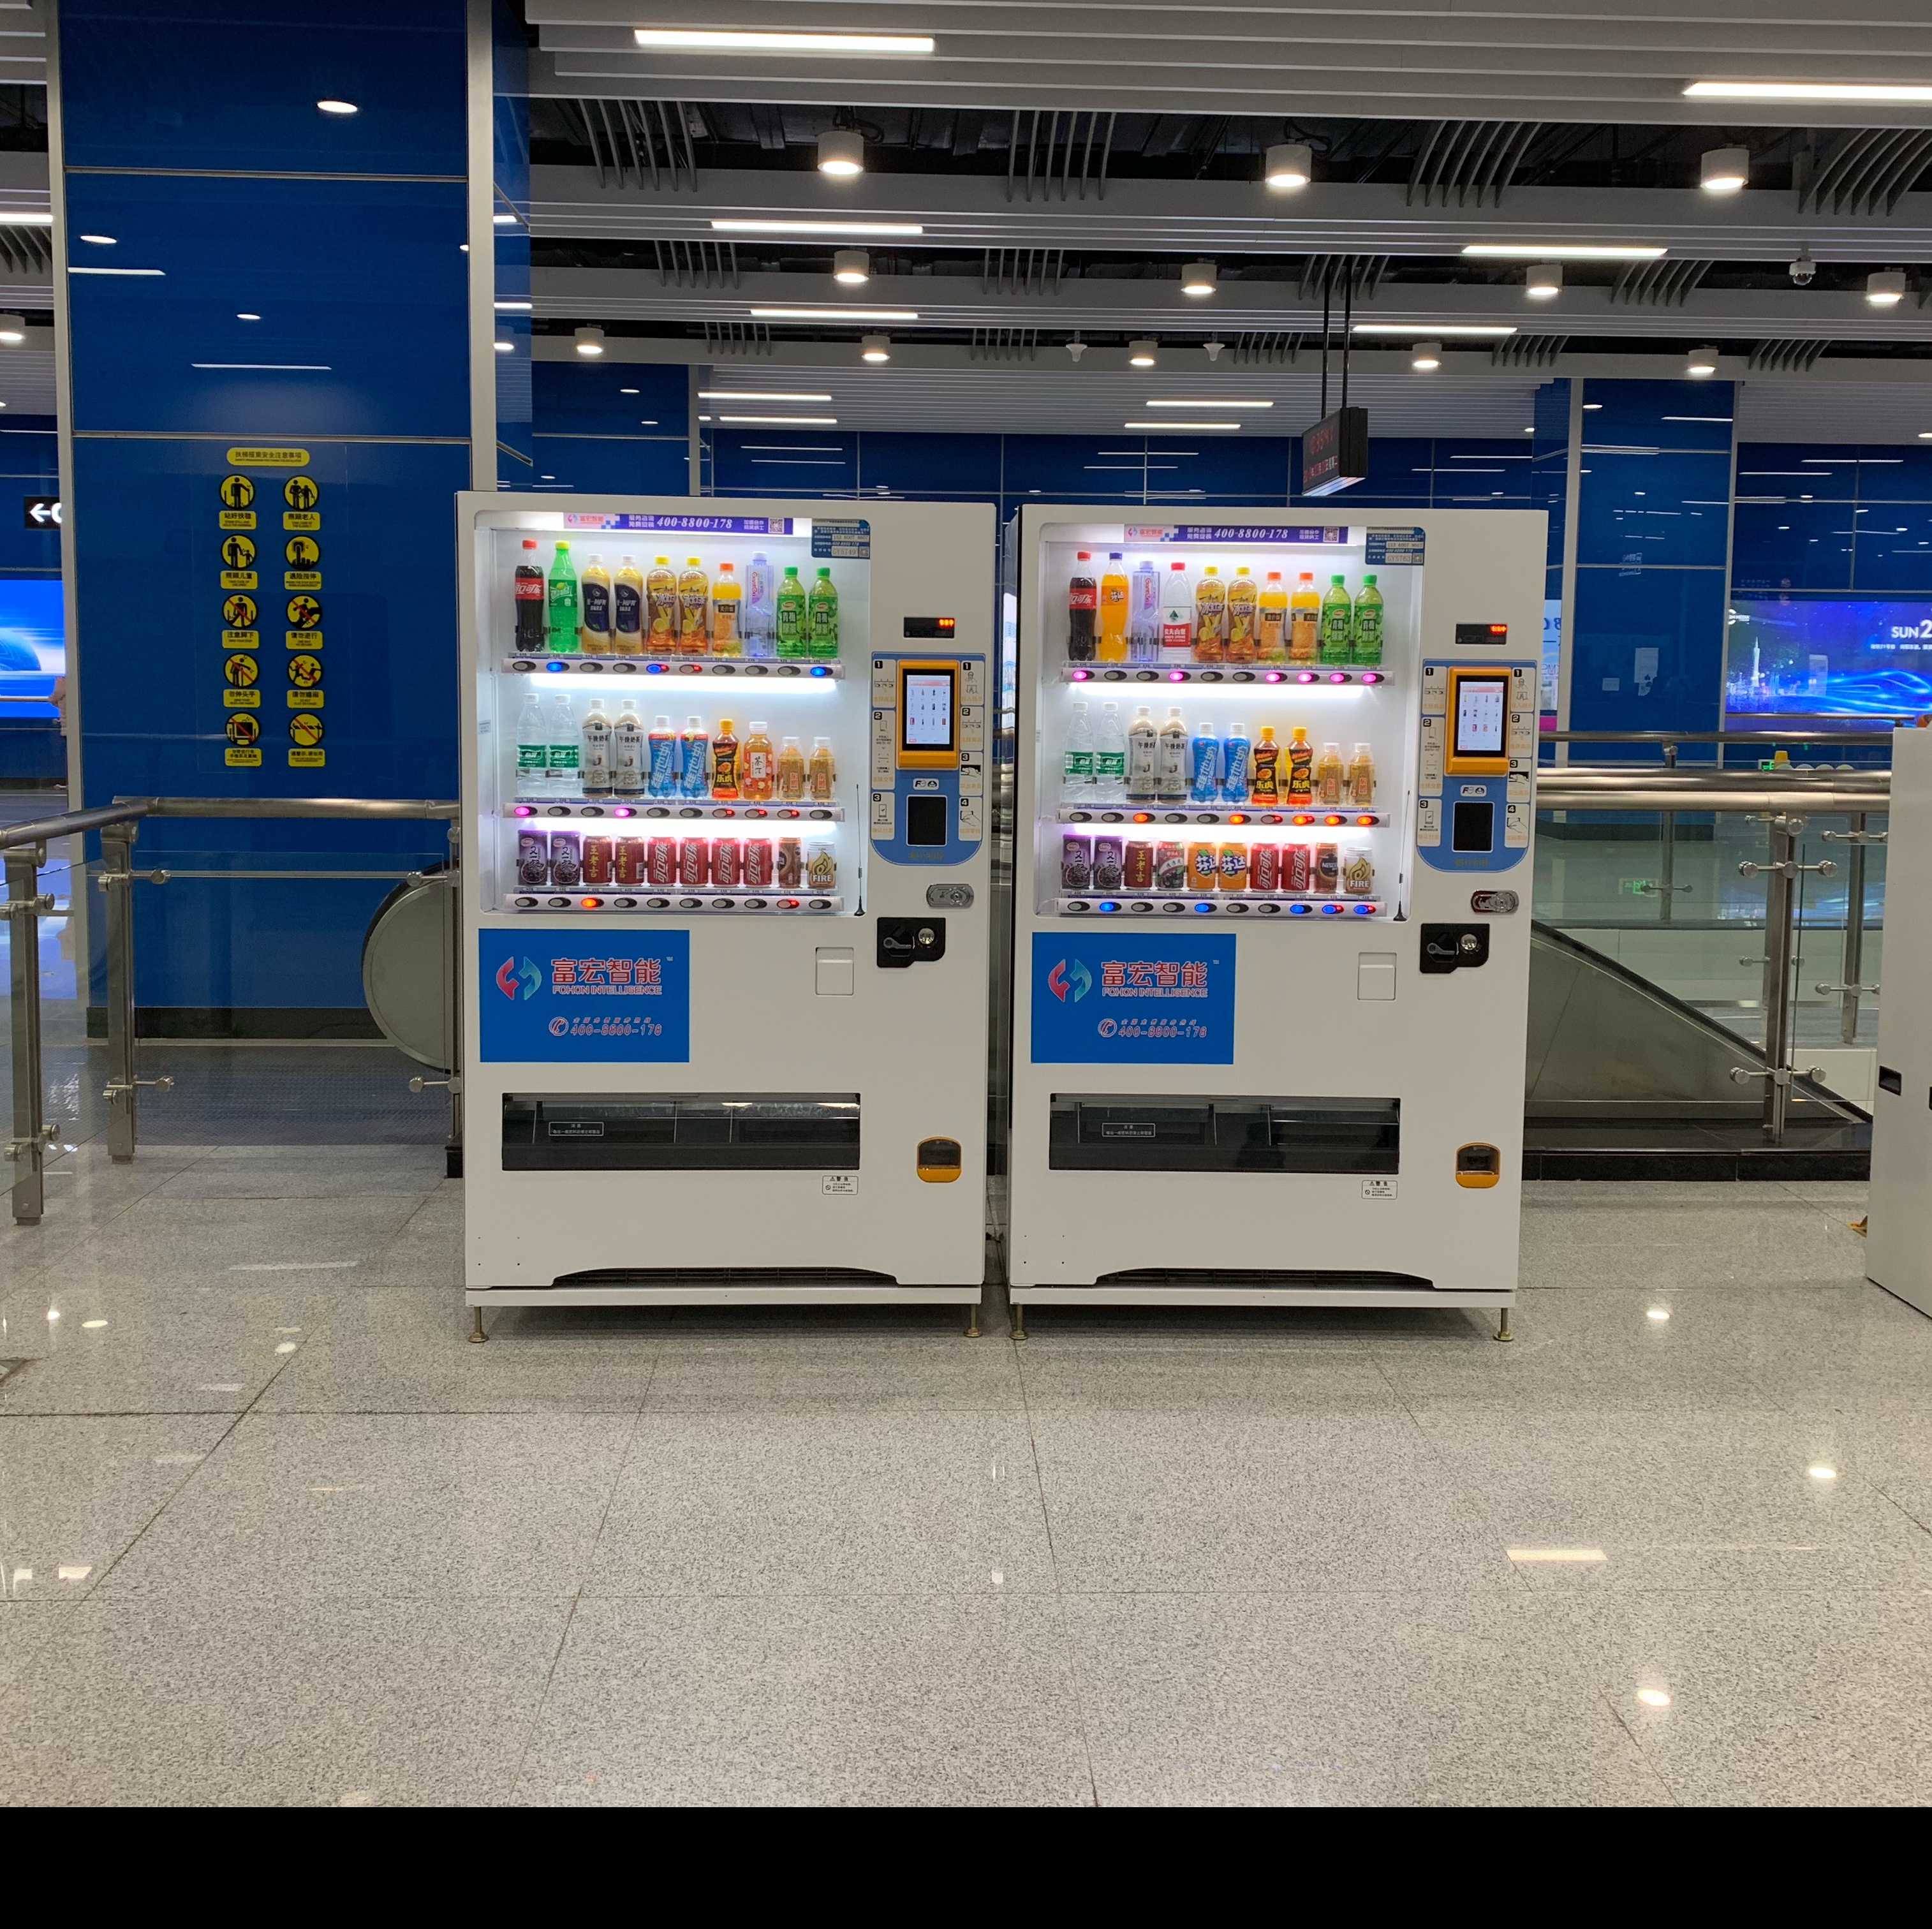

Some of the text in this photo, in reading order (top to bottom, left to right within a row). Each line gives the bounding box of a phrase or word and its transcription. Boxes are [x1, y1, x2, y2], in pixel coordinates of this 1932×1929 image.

[657, 516, 733, 529] 400-8800-178
[1214, 528, 1288, 539] 400-8800-178
[1256, 781, 1274, 789] 乐虎
[1292, 780, 1310, 788] 乐虎
[589, 845, 599, 878] 王老吉
[619, 845, 628, 878] 王老吉
[657, 842, 669, 883] 可口可乐
[685, 844, 698, 883] 可口可乐
[719, 844, 733, 884] 可口可乐
[748, 844, 760, 884] 可口可乐
[1136, 850, 1146, 882] 王老吉
[1221, 855, 1246, 871] 芬达
[1259, 849, 1272, 889] 可口可乐
[1294, 849, 1306, 889] 可口可乐
[551, 957, 661, 984] 富宏智能
[1101, 960, 1207, 987] 富宏智能
[552, 985, 662, 995] FOHON INTELLIGENCE
[1102, 988, 1208, 998] FOHON INTELLIGENCE
[570, 1024, 662, 1036] 400-8800-178
[1118, 1026, 1207, 1038] 400-8800-178
